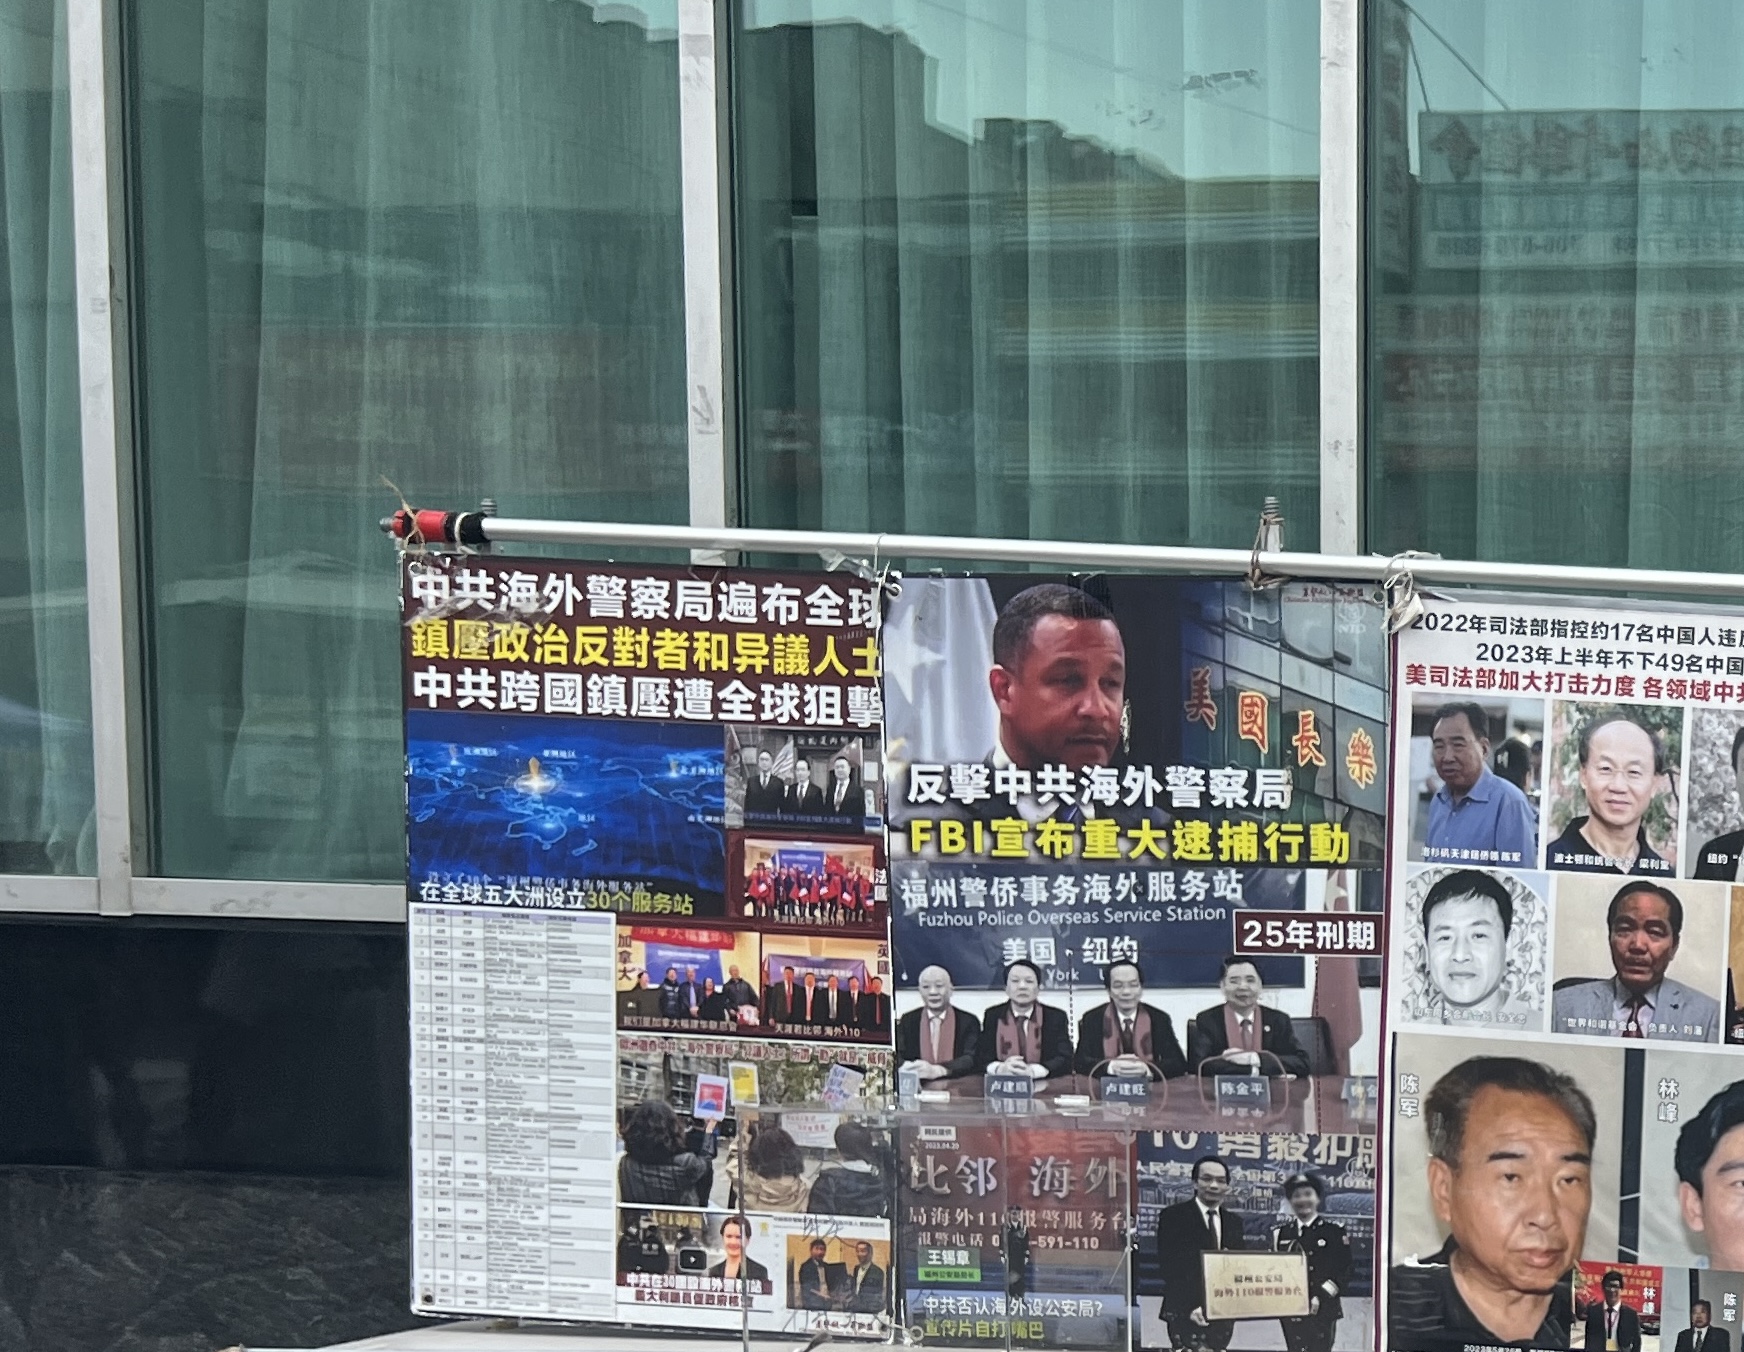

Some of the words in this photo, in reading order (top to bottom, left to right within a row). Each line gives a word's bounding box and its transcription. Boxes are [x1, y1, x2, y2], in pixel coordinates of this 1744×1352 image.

[412, 568, 880, 629] 中共海外警察局遍布全球
[1405, 664, 1637, 698] 美司法部加大打击力度
[908, 763, 1293, 811] 反擊中共海外警察局
[910, 818, 1351, 866] FBI宣布重大逮捕行動
[420, 881, 693, 916] 在全球五大洲设立30个服务站
[919, 912, 973, 926] Fuzhou
[978, 911, 1023, 926] Police
[1028, 909, 1099, 926] Overseas
[1103, 906, 1163, 922] Service
[1167, 906, 1226, 921] Station
[1243, 918, 1376, 950] 25年刑期
[1220, 1080, 1265, 1097] 陈金平
[1400, 1073, 1420, 1118] 陈军
[1659, 1078, 1679, 1123] 林峰
